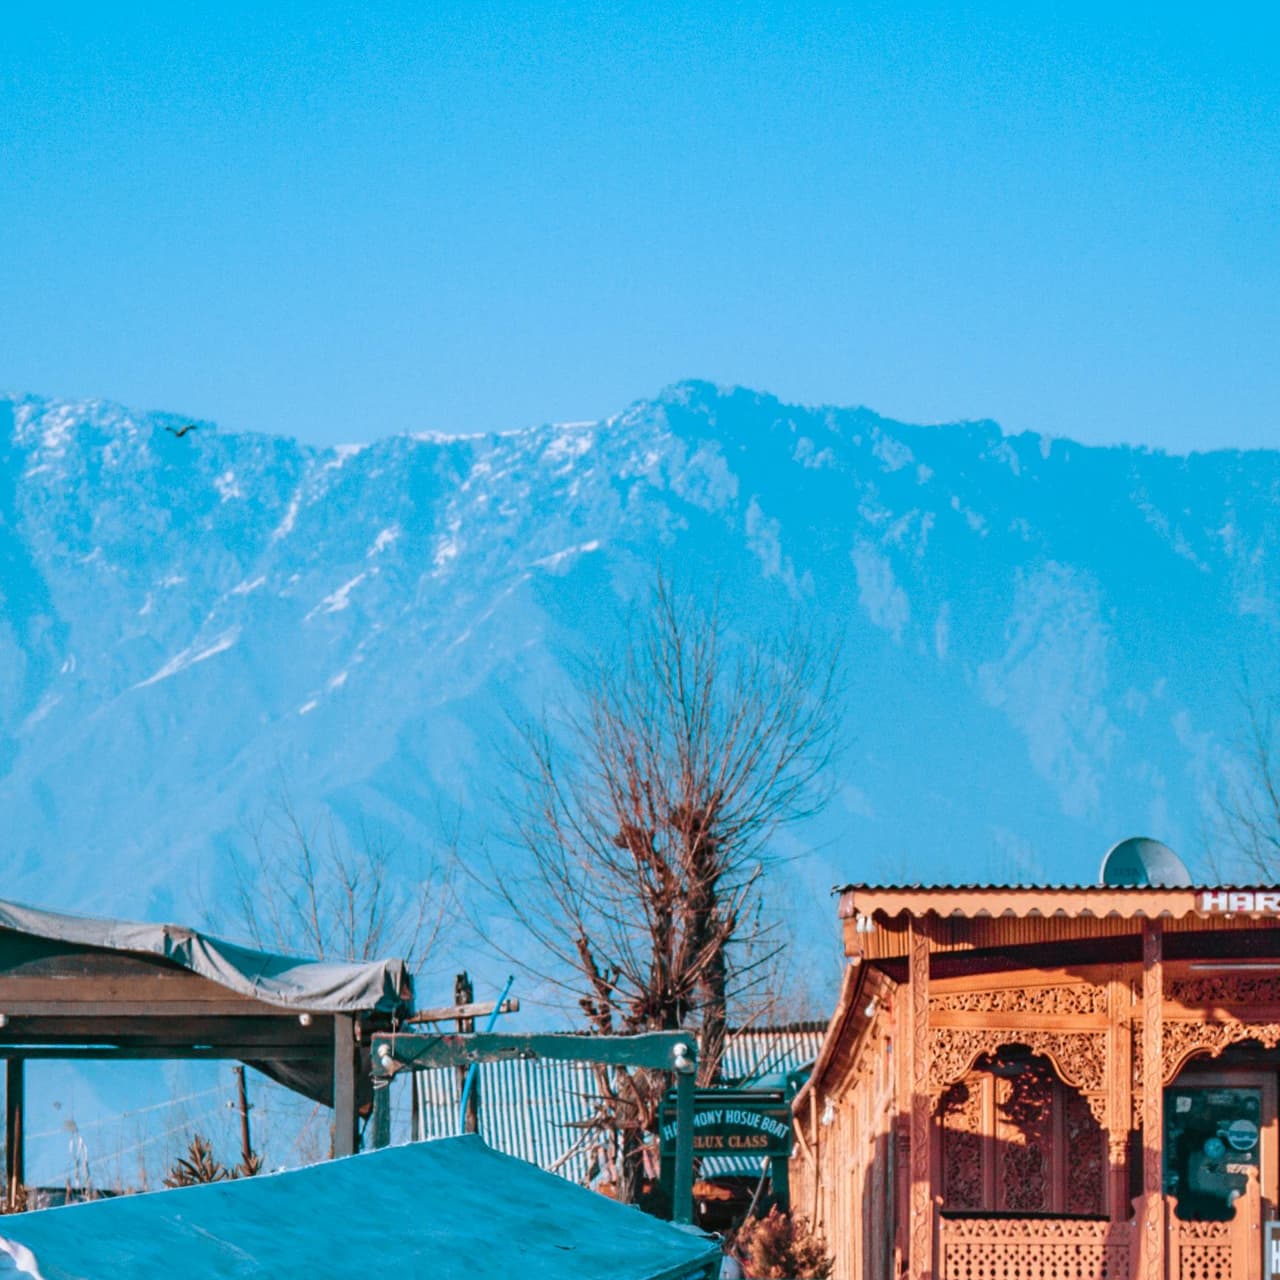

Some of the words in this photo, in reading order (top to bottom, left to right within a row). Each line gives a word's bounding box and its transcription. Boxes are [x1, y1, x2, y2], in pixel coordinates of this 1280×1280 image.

[725, 1109, 762, 1129] HOSUE
[761, 1116, 790, 1139] BOAT
[727, 1134, 769, 1149] CLASS
